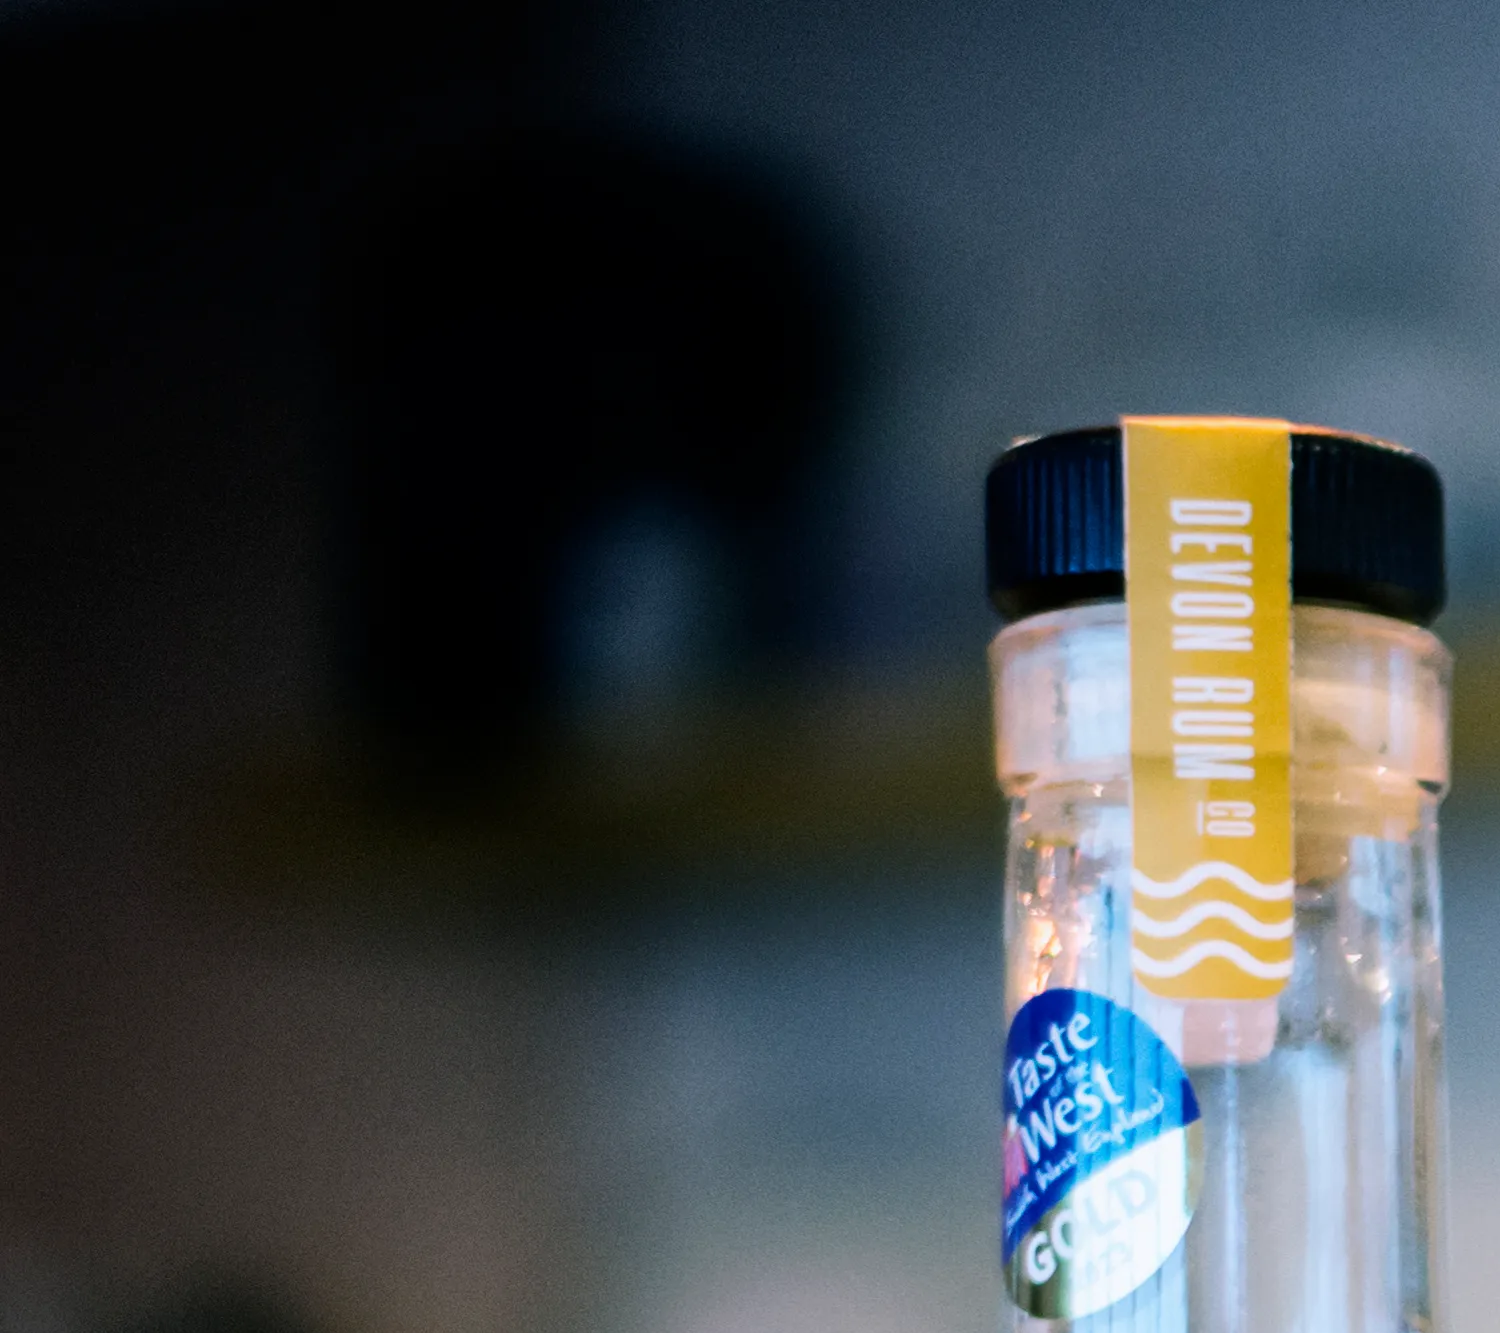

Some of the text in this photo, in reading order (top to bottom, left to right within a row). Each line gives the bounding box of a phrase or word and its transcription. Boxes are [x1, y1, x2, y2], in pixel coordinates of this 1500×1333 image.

[1168, 498, 1256, 838] DEVON RUM CO
[1008, 1011, 1099, 1108] Taste
[1020, 1062, 1126, 1164] West
[1026, 1168, 1158, 1285] GOLD
